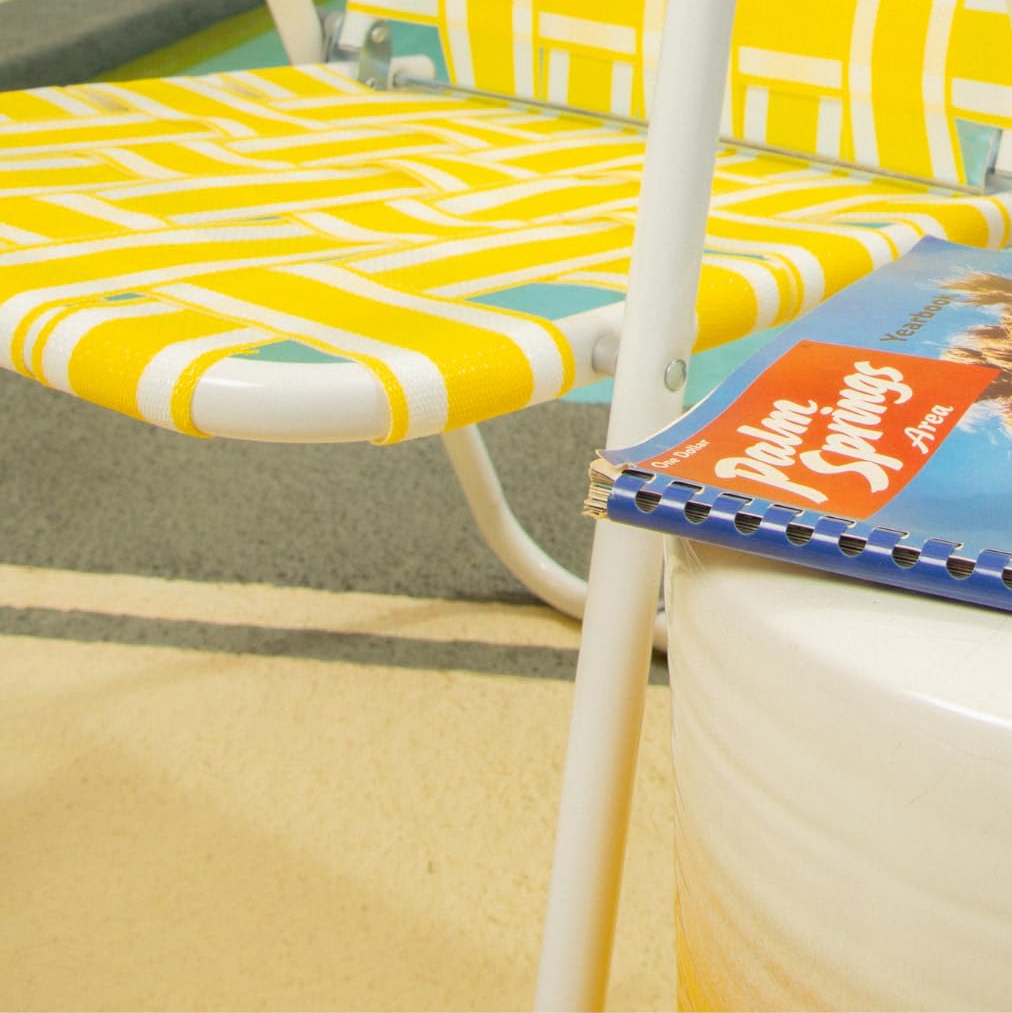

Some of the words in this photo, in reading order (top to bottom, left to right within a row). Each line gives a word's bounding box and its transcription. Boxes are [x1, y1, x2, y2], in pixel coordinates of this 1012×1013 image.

[880, 292, 957, 344] Yearbook
[714, 398, 829, 504] Palm
[800, 360, 913, 494] Springs
[904, 403, 954, 454] Area
[651, 454, 680, 471] One
[676, 438, 711, 459] Dollar
